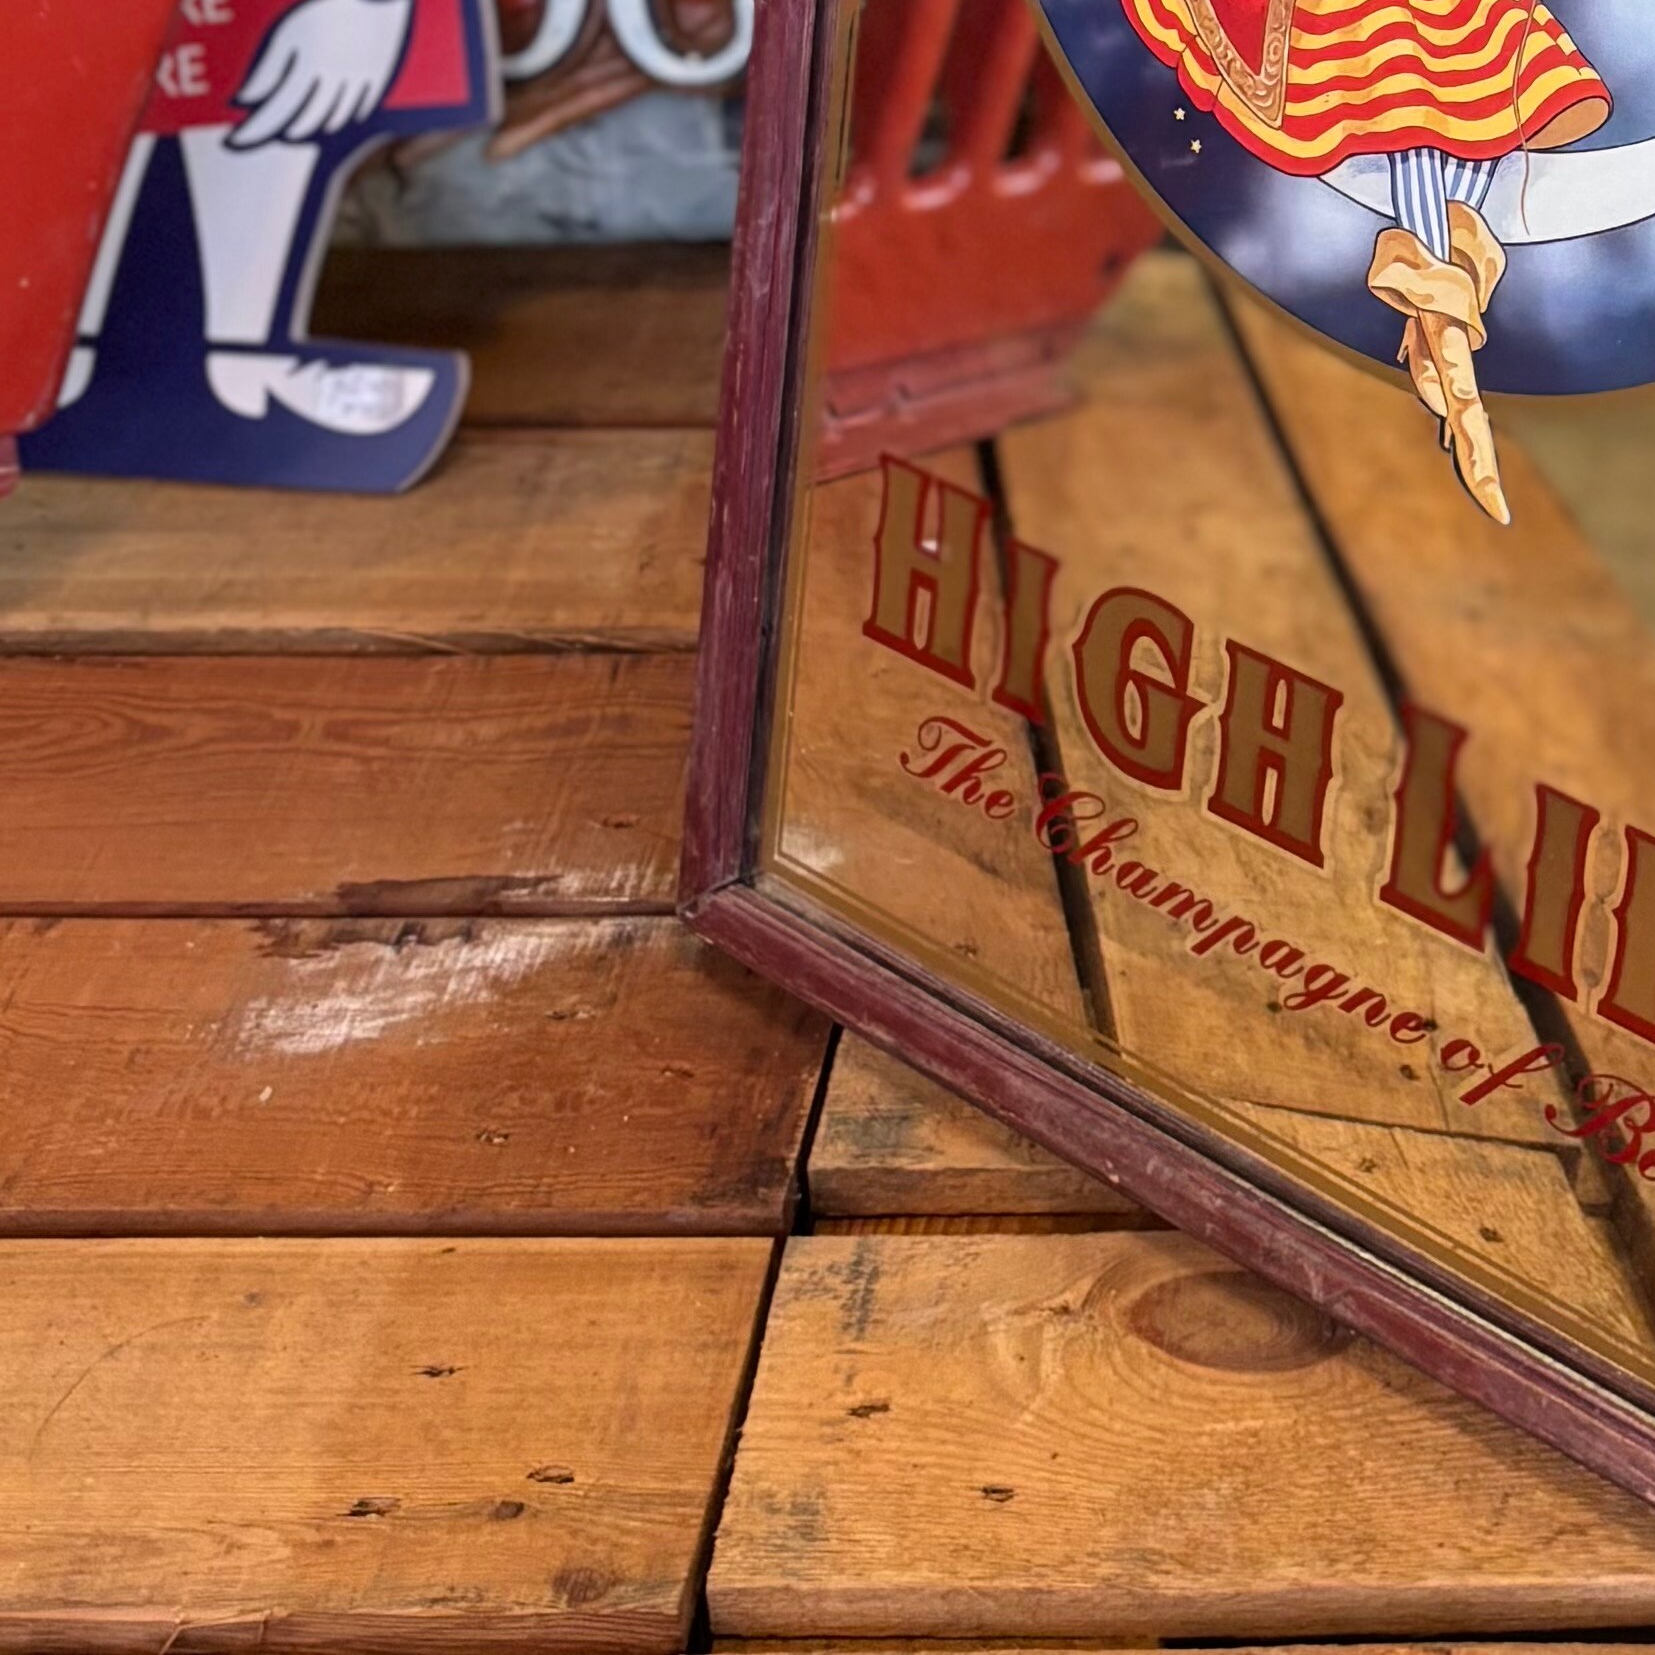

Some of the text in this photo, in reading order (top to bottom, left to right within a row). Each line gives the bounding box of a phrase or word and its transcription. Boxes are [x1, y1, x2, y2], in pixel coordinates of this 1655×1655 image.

[862, 451, 1344, 870] HIGH
[899, 714, 1016, 821] The
[1033, 772, 1429, 1045] Champagne
[1439, 1042, 1565, 1106] of
